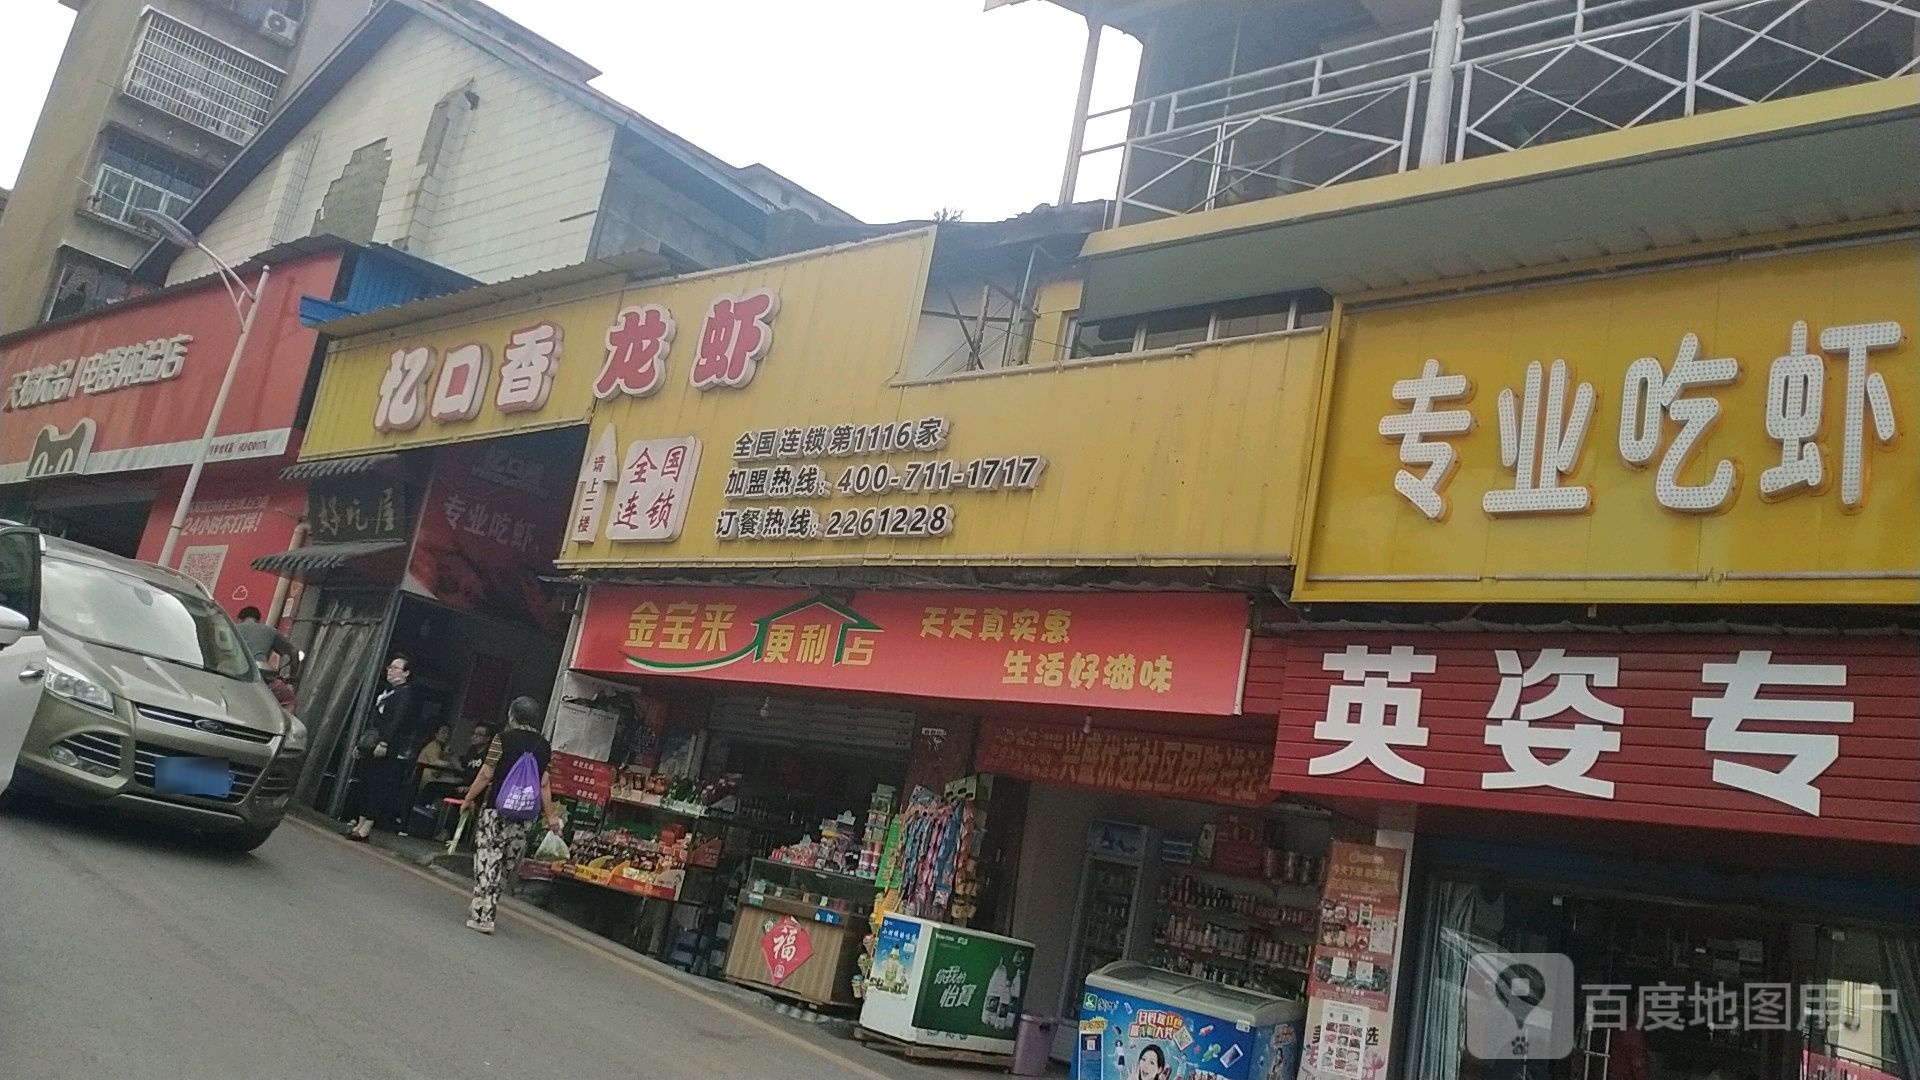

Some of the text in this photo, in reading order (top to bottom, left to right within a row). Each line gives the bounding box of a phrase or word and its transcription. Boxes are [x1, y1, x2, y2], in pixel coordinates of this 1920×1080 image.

[732, 416, 948, 460] 全国连锁第1116家
[1378, 320, 1903, 520] 专业吃虾
[626, 445, 688, 484] 全国
[576, 453, 608, 534] 请上二楼
[612, 492, 676, 532] 连锁
[442, 494, 538, 552] 专业吃虾
[919, 606, 1073, 644] 天天真实惠
[1002, 649, 1173, 693] 生活好滋味
[1307, 645, 1854, 817] 英姿专
[772, 925, 799, 962] 福
